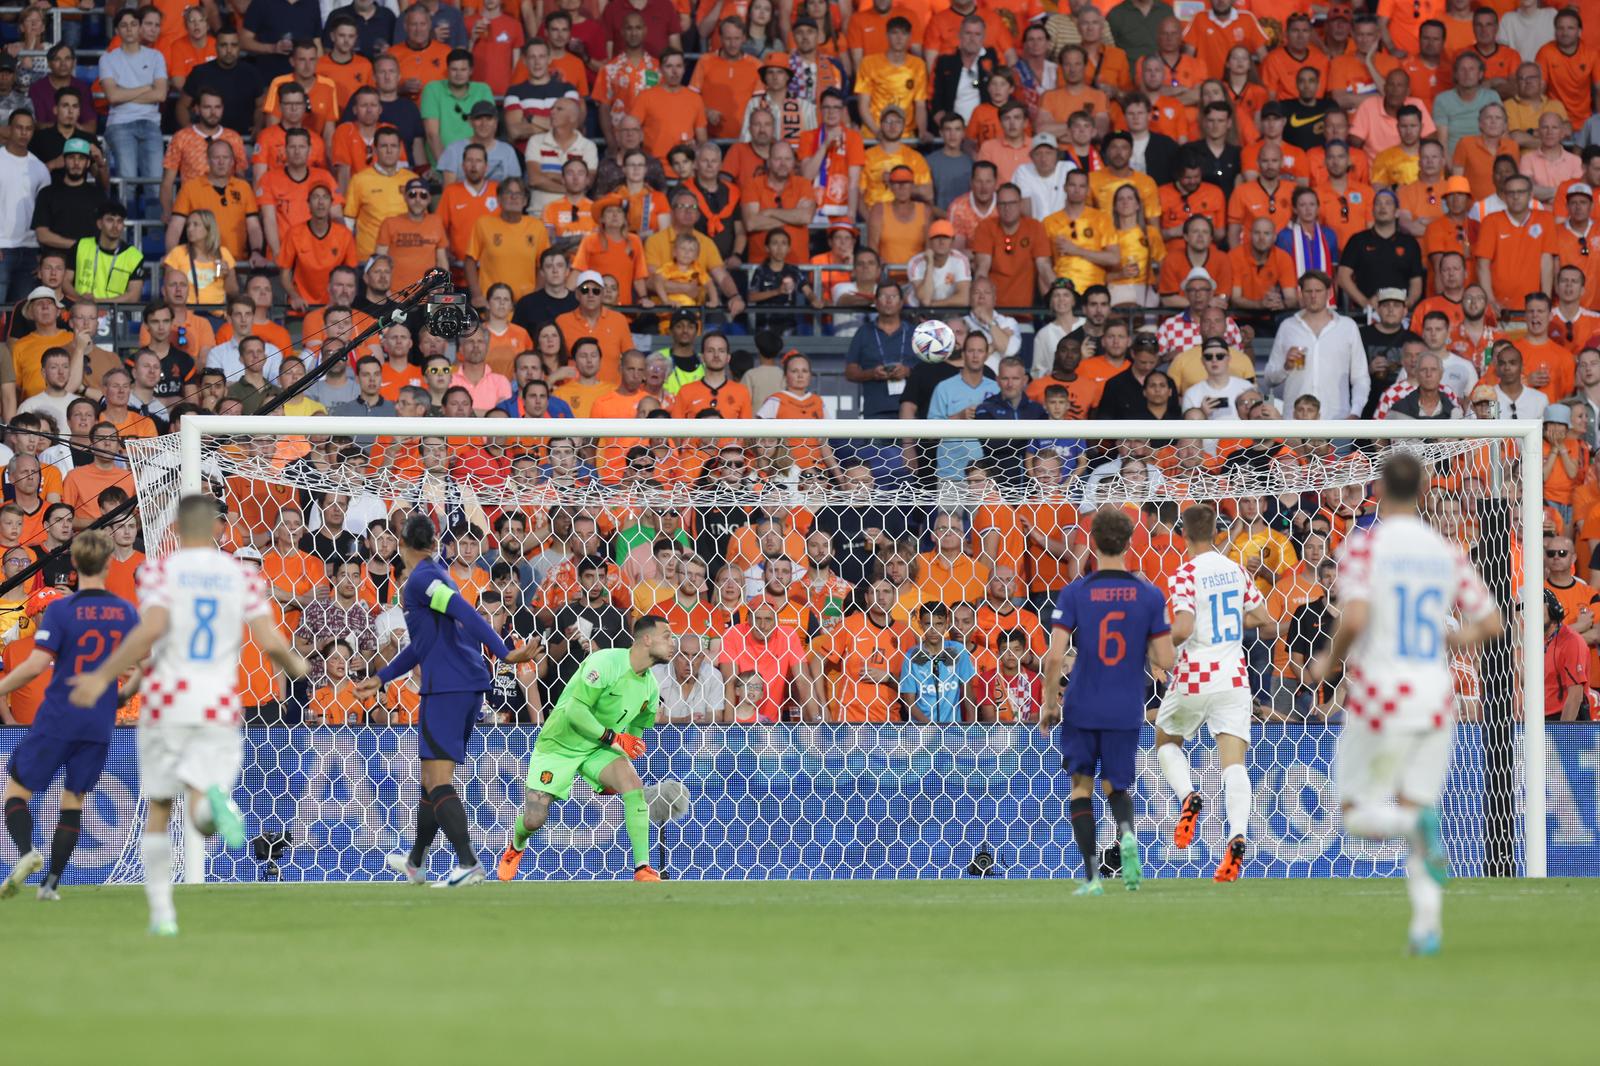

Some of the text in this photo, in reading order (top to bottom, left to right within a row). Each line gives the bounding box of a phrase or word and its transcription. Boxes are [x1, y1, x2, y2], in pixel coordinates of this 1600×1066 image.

[189, 597, 217, 660] 8
[1098, 610, 1127, 667] 6
[1208, 589, 1242, 645] 15
[1395, 586, 1443, 659] 16
